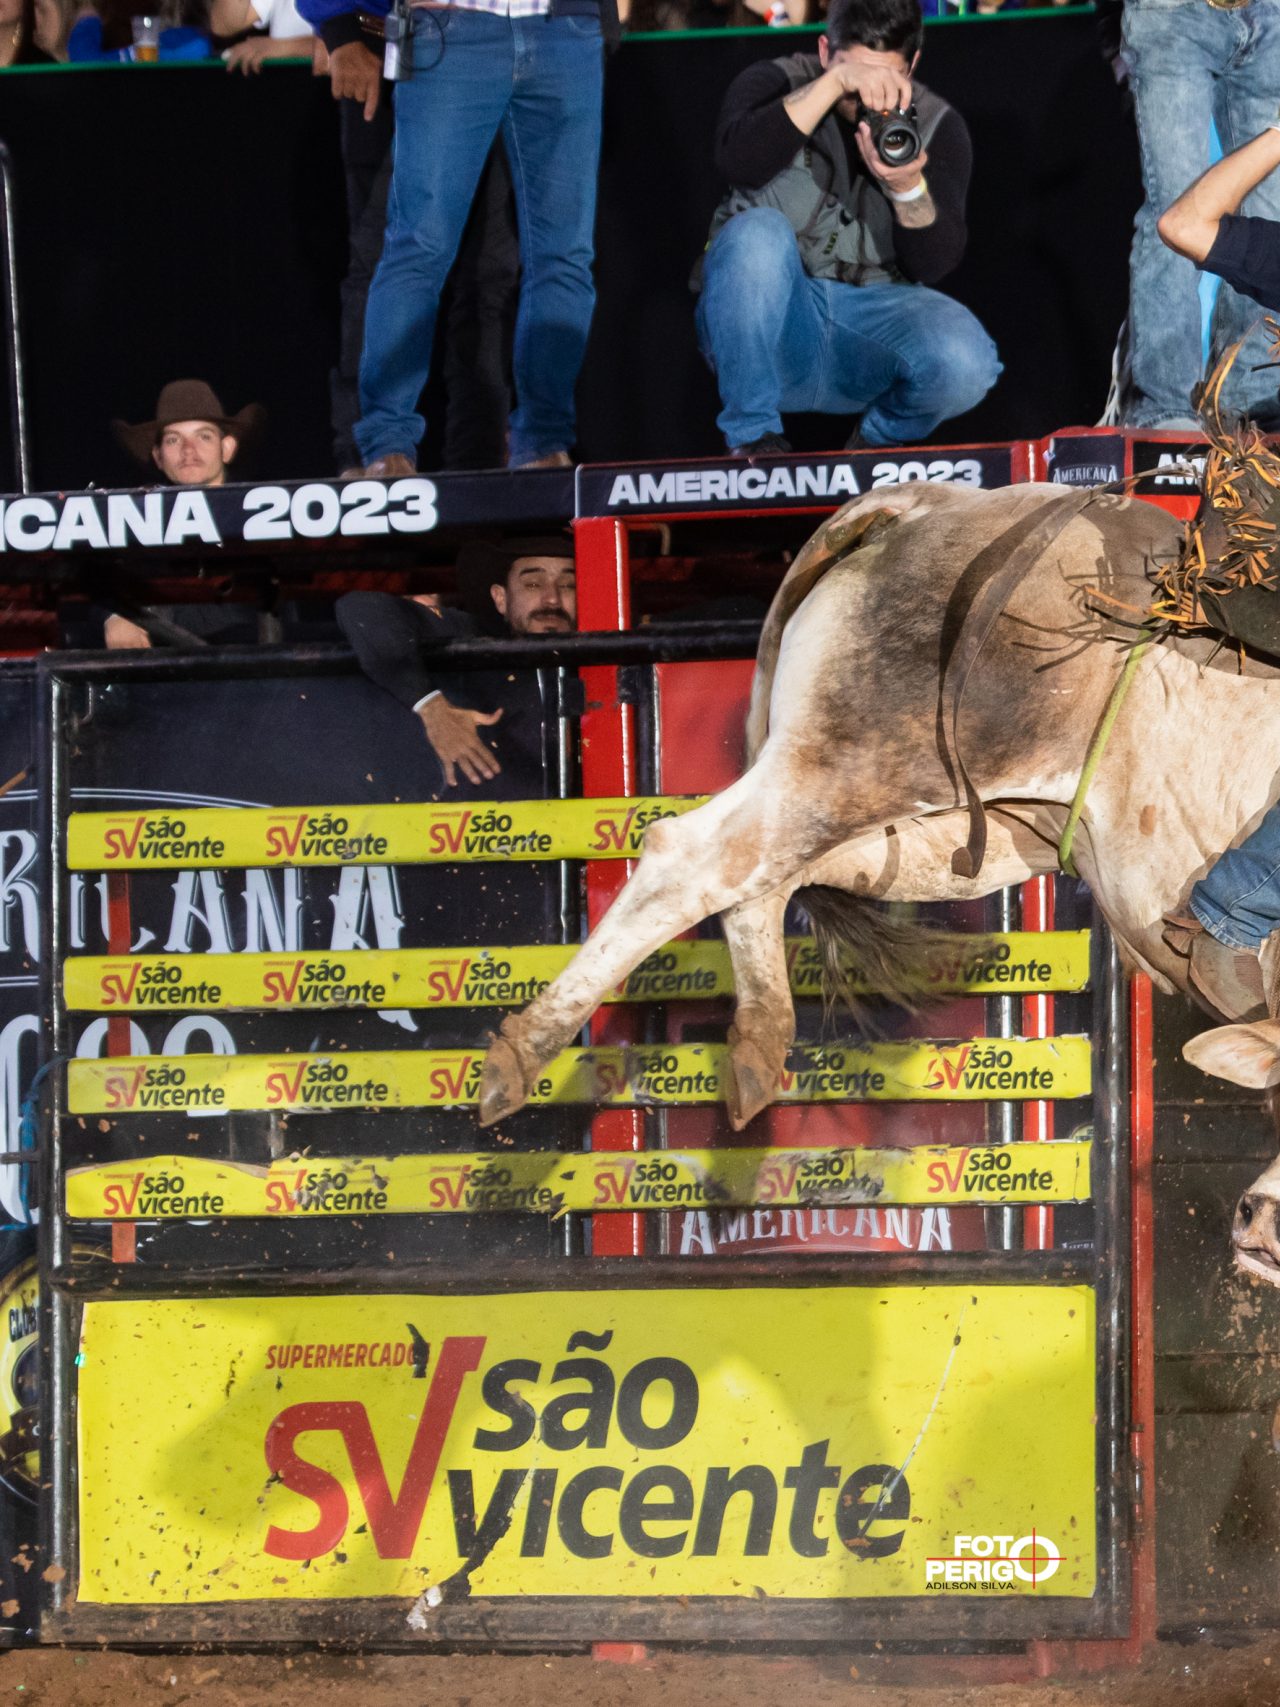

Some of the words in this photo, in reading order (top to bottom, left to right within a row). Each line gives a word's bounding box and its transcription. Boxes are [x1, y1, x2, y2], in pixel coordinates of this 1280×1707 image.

[608, 464, 860, 506] AMERICANA
[243, 478, 438, 541] 2023
[145, 816, 185, 838] são
[306, 813, 348, 835] são
[429, 811, 472, 854] SV
[470, 810, 512, 832] são
[594, 807, 637, 850] SV
[104, 816, 146, 859] SV
[138, 836, 224, 858] vicente
[266, 814, 308, 857] SV
[301, 833, 387, 856] vicente
[465, 830, 552, 853] vicente
[140, 962, 182, 984] são
[303, 960, 346, 982] são
[428, 959, 471, 1002] SV
[469, 958, 511, 980] são
[100, 962, 142, 1005] SV
[262, 960, 305, 1002] SV
[297, 980, 386, 1003] vicente
[135, 982, 221, 1005] vicente
[970, 1047, 1012, 1068] são
[145, 1063, 186, 1086] são
[266, 1061, 308, 1105] SV
[306, 1060, 348, 1083] são
[429, 1056, 472, 1099] SV
[963, 1066, 1054, 1089] vicente
[104, 1065, 146, 1109] SV
[139, 1084, 225, 1106] vicente
[301, 1080, 388, 1103] vicente
[635, 1159, 677, 1182] são
[927, 1149, 969, 1193] SV
[968, 1150, 1011, 1172] são
[143, 1172, 184, 1194] são
[429, 1165, 472, 1209] SV
[594, 1160, 637, 1204] SV
[630, 1180, 718, 1203] vicent
[963, 1169, 1053, 1192] vicente
[103, 1172, 145, 1215] SV
[138, 1191, 224, 1215] vicente
[265, 1343, 431, 1370] SUPERMERCAD
[473, 1330, 700, 1452] são
[263, 1336, 487, 1560] SV
[447, 1438, 911, 1558] vicente
